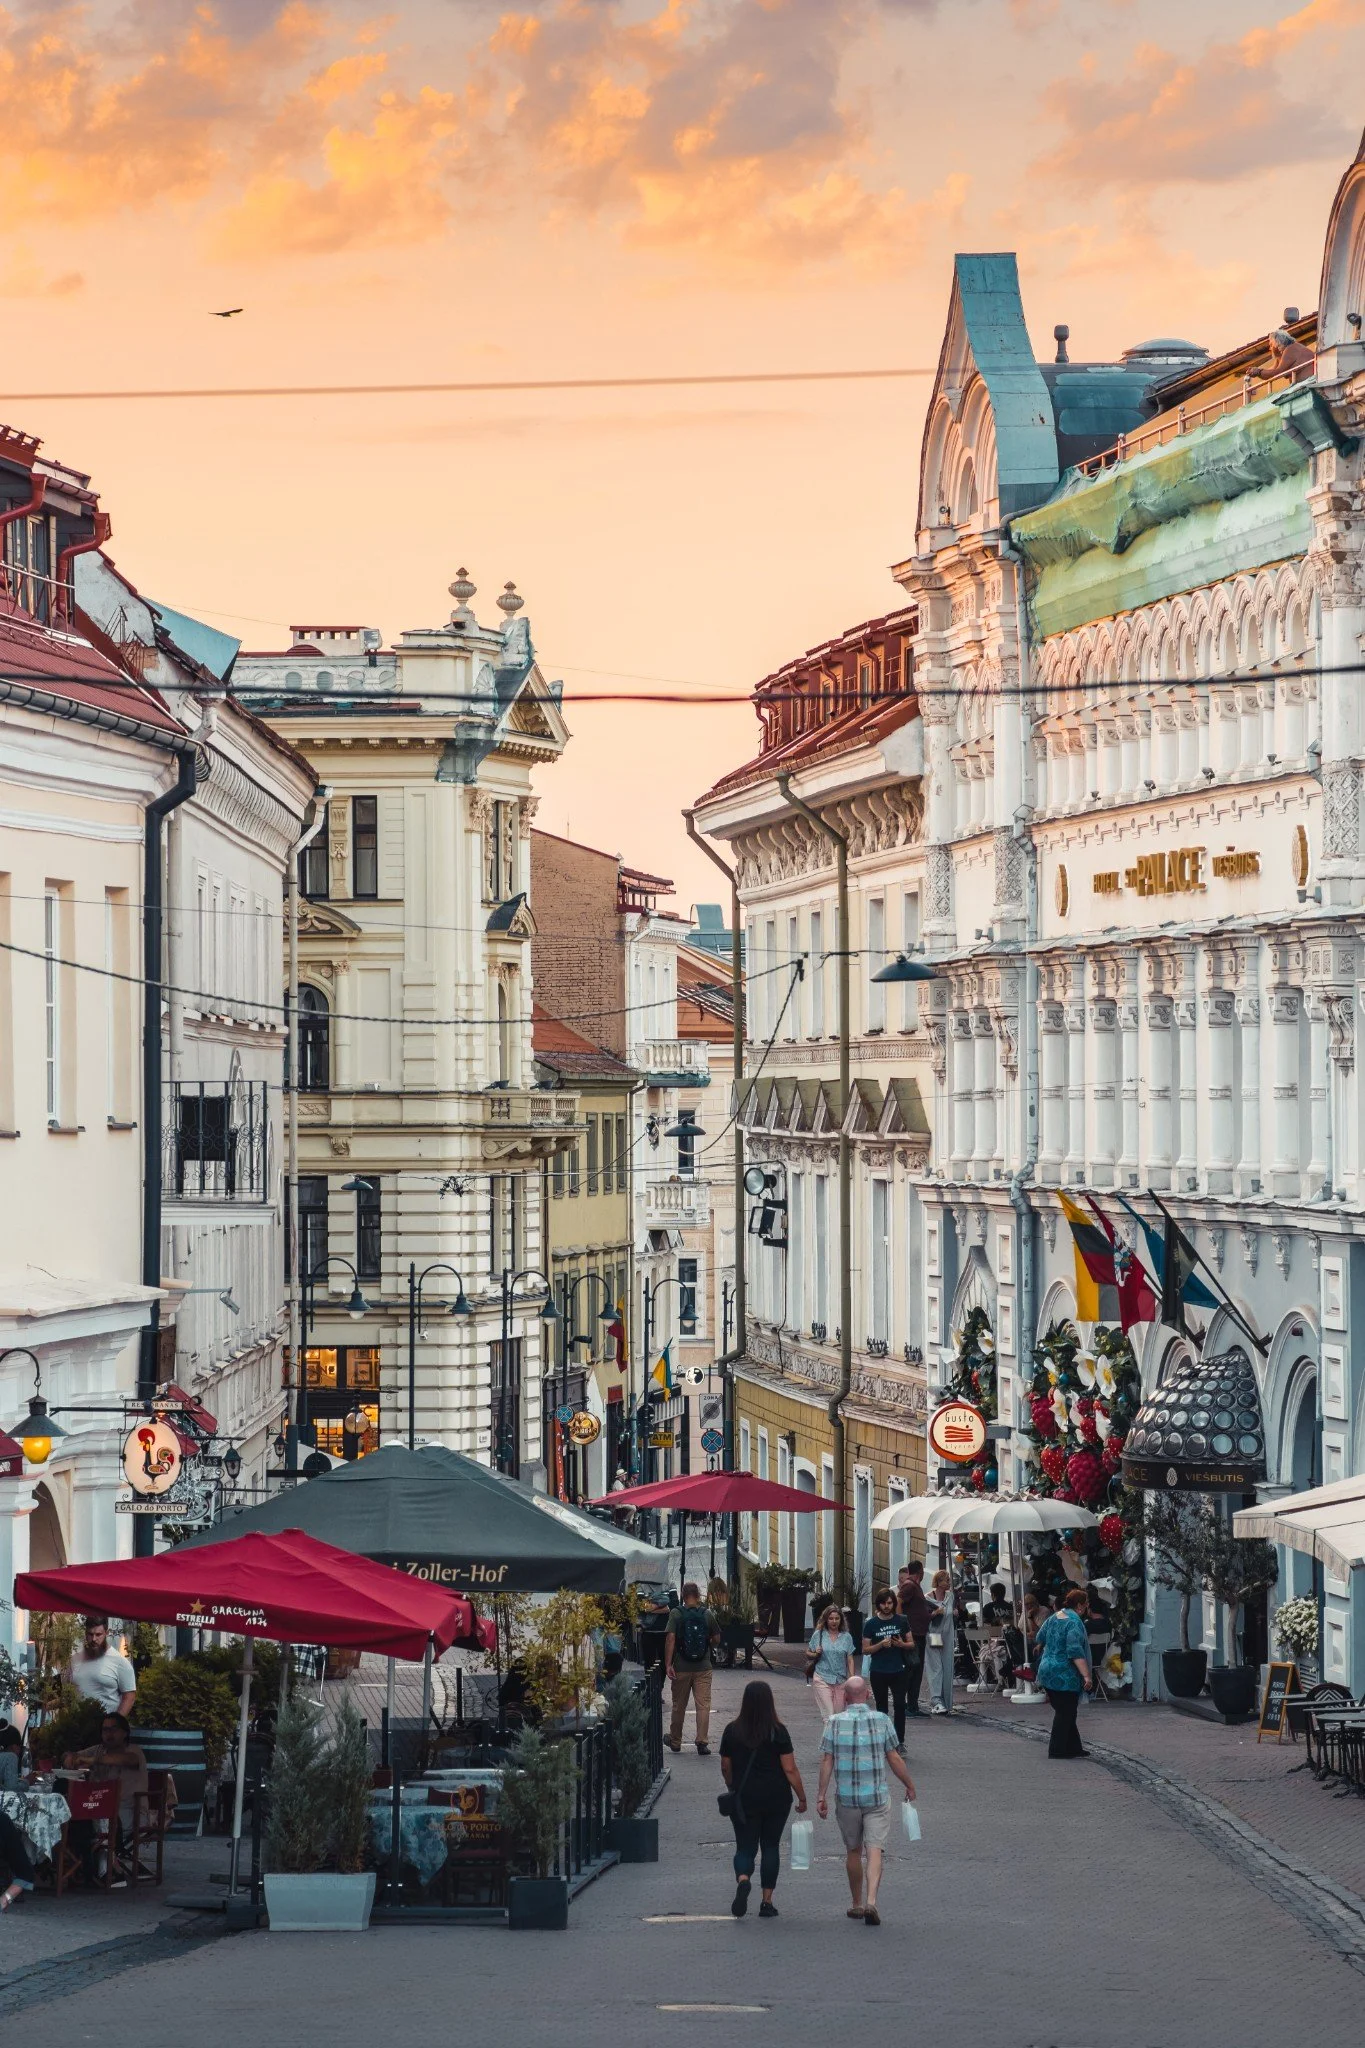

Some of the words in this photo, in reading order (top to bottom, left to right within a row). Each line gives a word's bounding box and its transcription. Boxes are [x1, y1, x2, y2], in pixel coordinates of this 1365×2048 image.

[1136, 846, 1206, 896] PALACE
[945, 1411, 974, 1422] Gusto
[1185, 1472, 1244, 1482] VIEŠBUTIS
[156, 1504, 183, 1512] PORTO
[406, 1562, 508, 1582] Zoller-Hof
[211, 1606, 265, 1616] BARCELONA
[176, 1613, 215, 1625] ESTRELLA
[245, 1617, 267, 1627] 1876
[470, 1823, 502, 1832] PORTO
